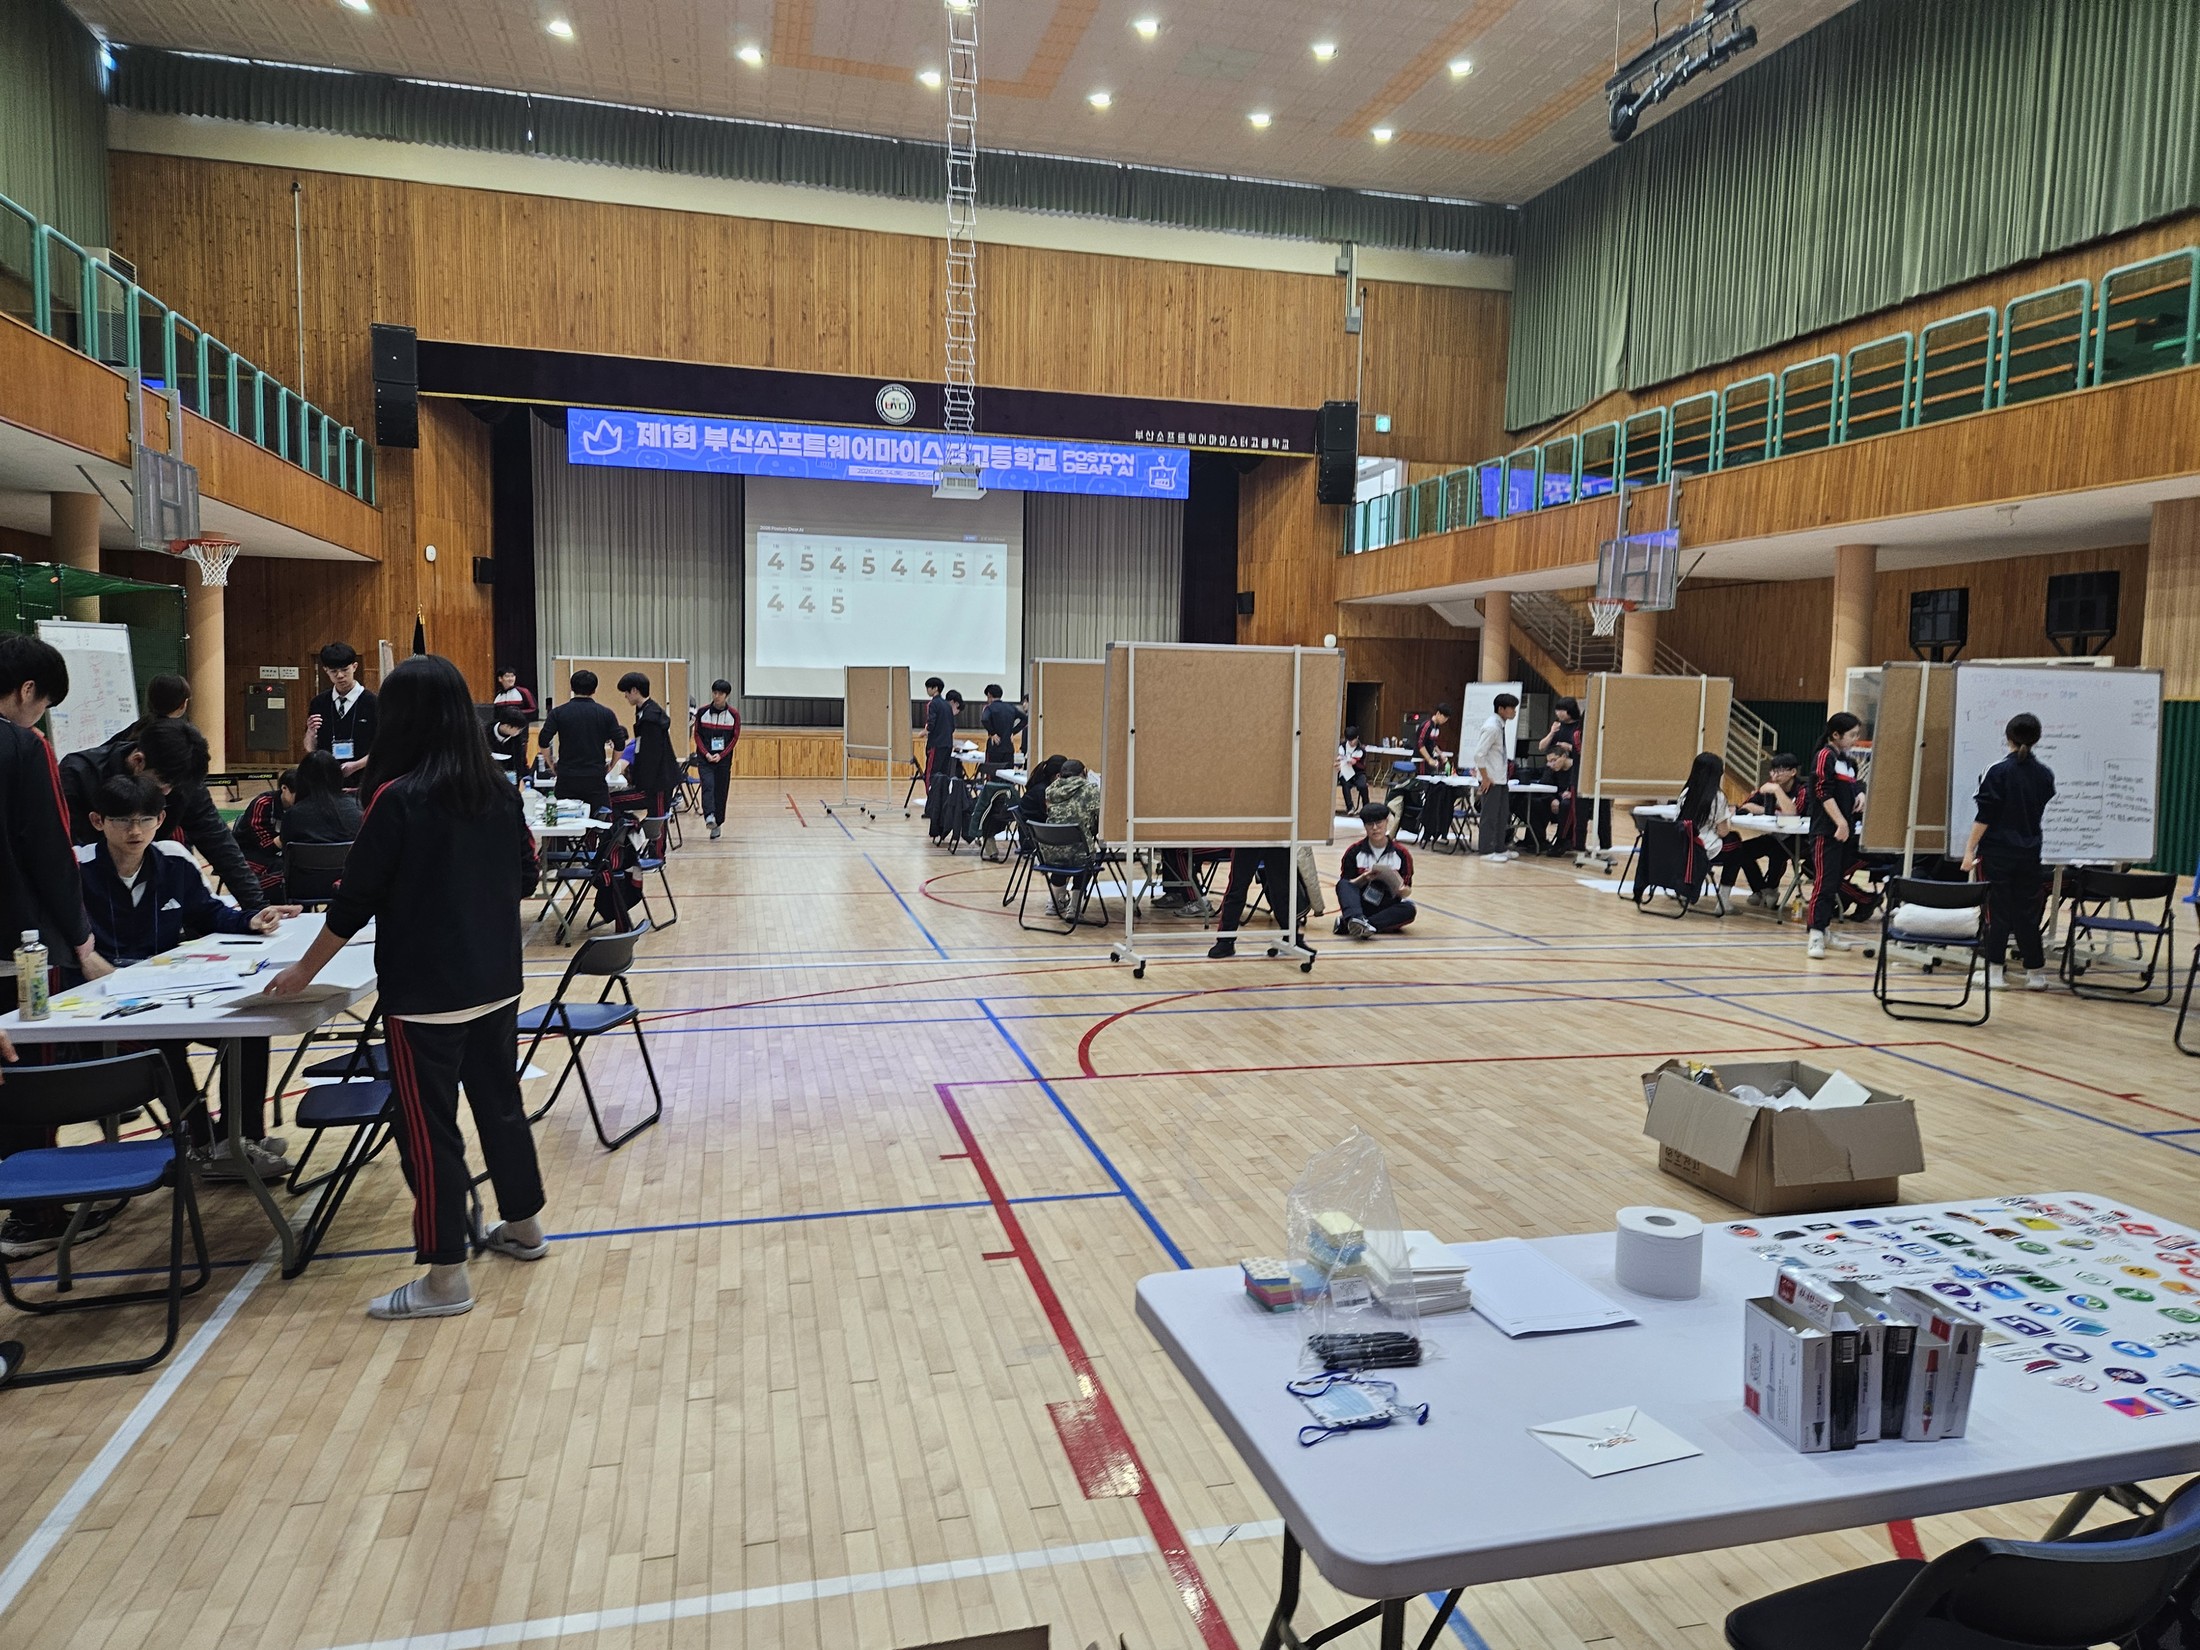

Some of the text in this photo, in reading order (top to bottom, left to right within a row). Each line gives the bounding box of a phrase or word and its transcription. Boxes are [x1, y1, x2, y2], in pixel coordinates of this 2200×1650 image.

[636, 421, 1057, 472] 제1회 부산소프트웨어마이스터고등학교
[1135, 429, 1289, 450] 부산소프트웨어마이스터고등학교
[1062, 450, 1134, 466] POSTON
[1062, 462, 1134, 477] DEAR AI
[768, 553, 784, 570] 4
[800, 554, 814, 572] 5
[830, 556, 846, 573] 4
[862, 557, 875, 574] 5
[891, 559, 907, 576] 4
[921, 560, 937, 577] 4
[952, 561, 965, 578] 5
[982, 562, 997, 580] 4
[767, 594, 784, 612] 4
[799, 595, 815, 613] 4
[831, 596, 844, 614] 5
